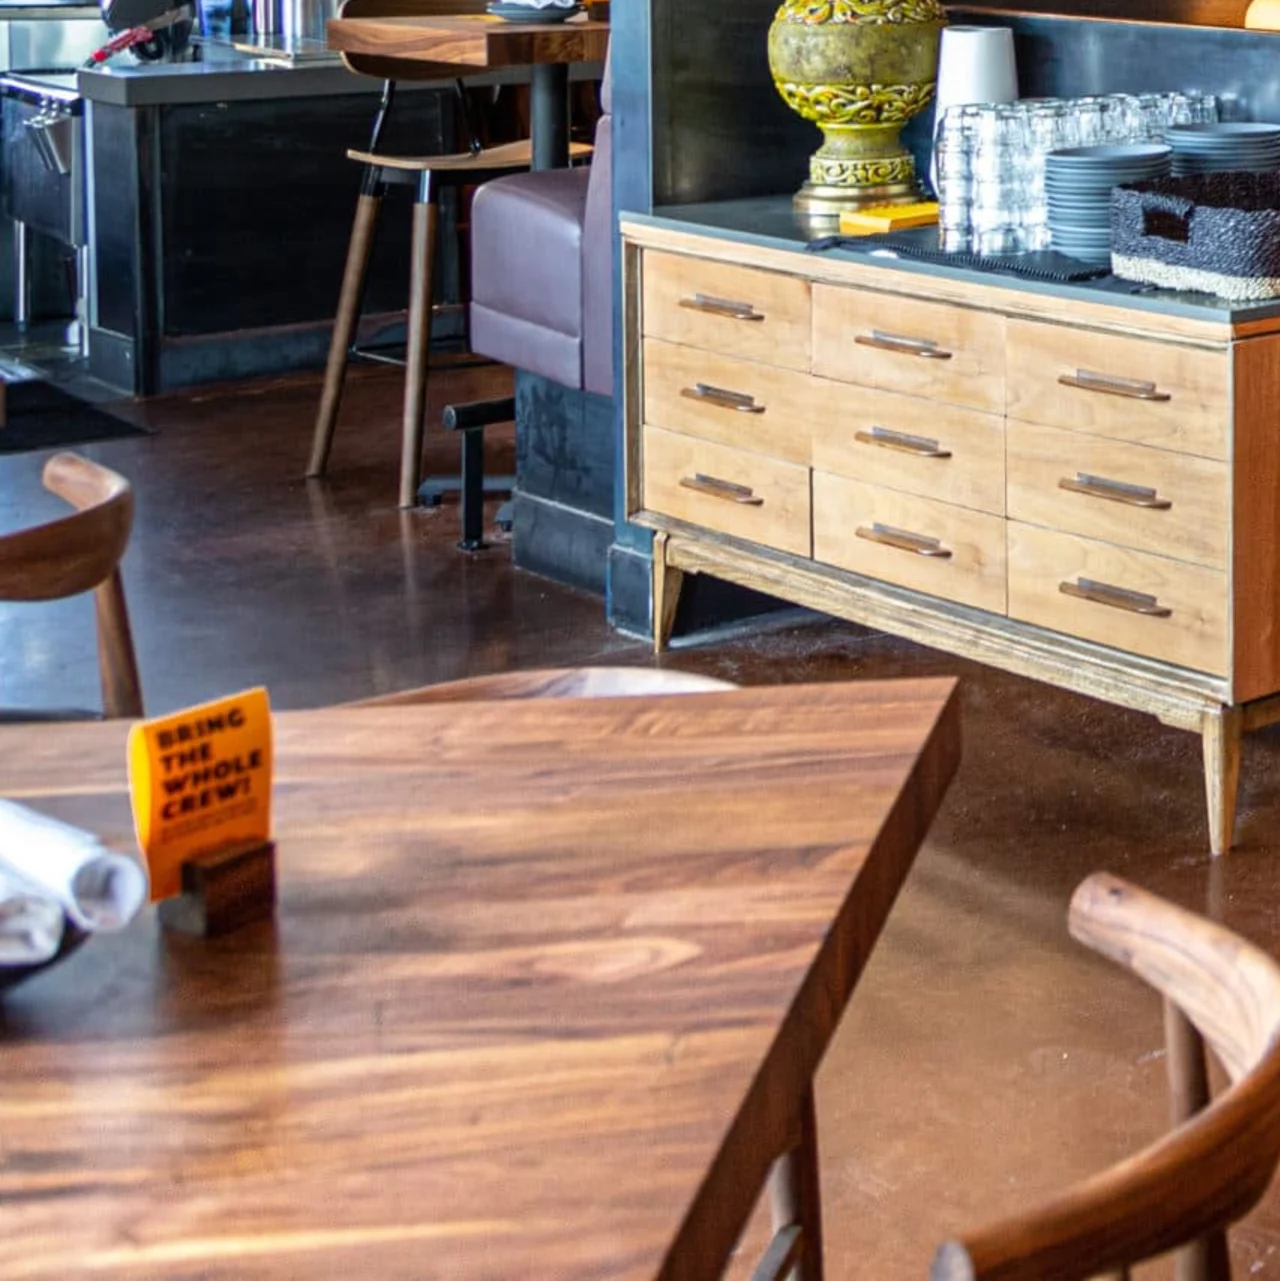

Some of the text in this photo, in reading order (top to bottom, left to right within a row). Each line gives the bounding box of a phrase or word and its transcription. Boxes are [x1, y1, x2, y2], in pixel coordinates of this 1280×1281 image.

[157, 707, 245, 749] BRING
[162, 741, 211, 773] THE
[163, 749, 262, 795] WHOLE
